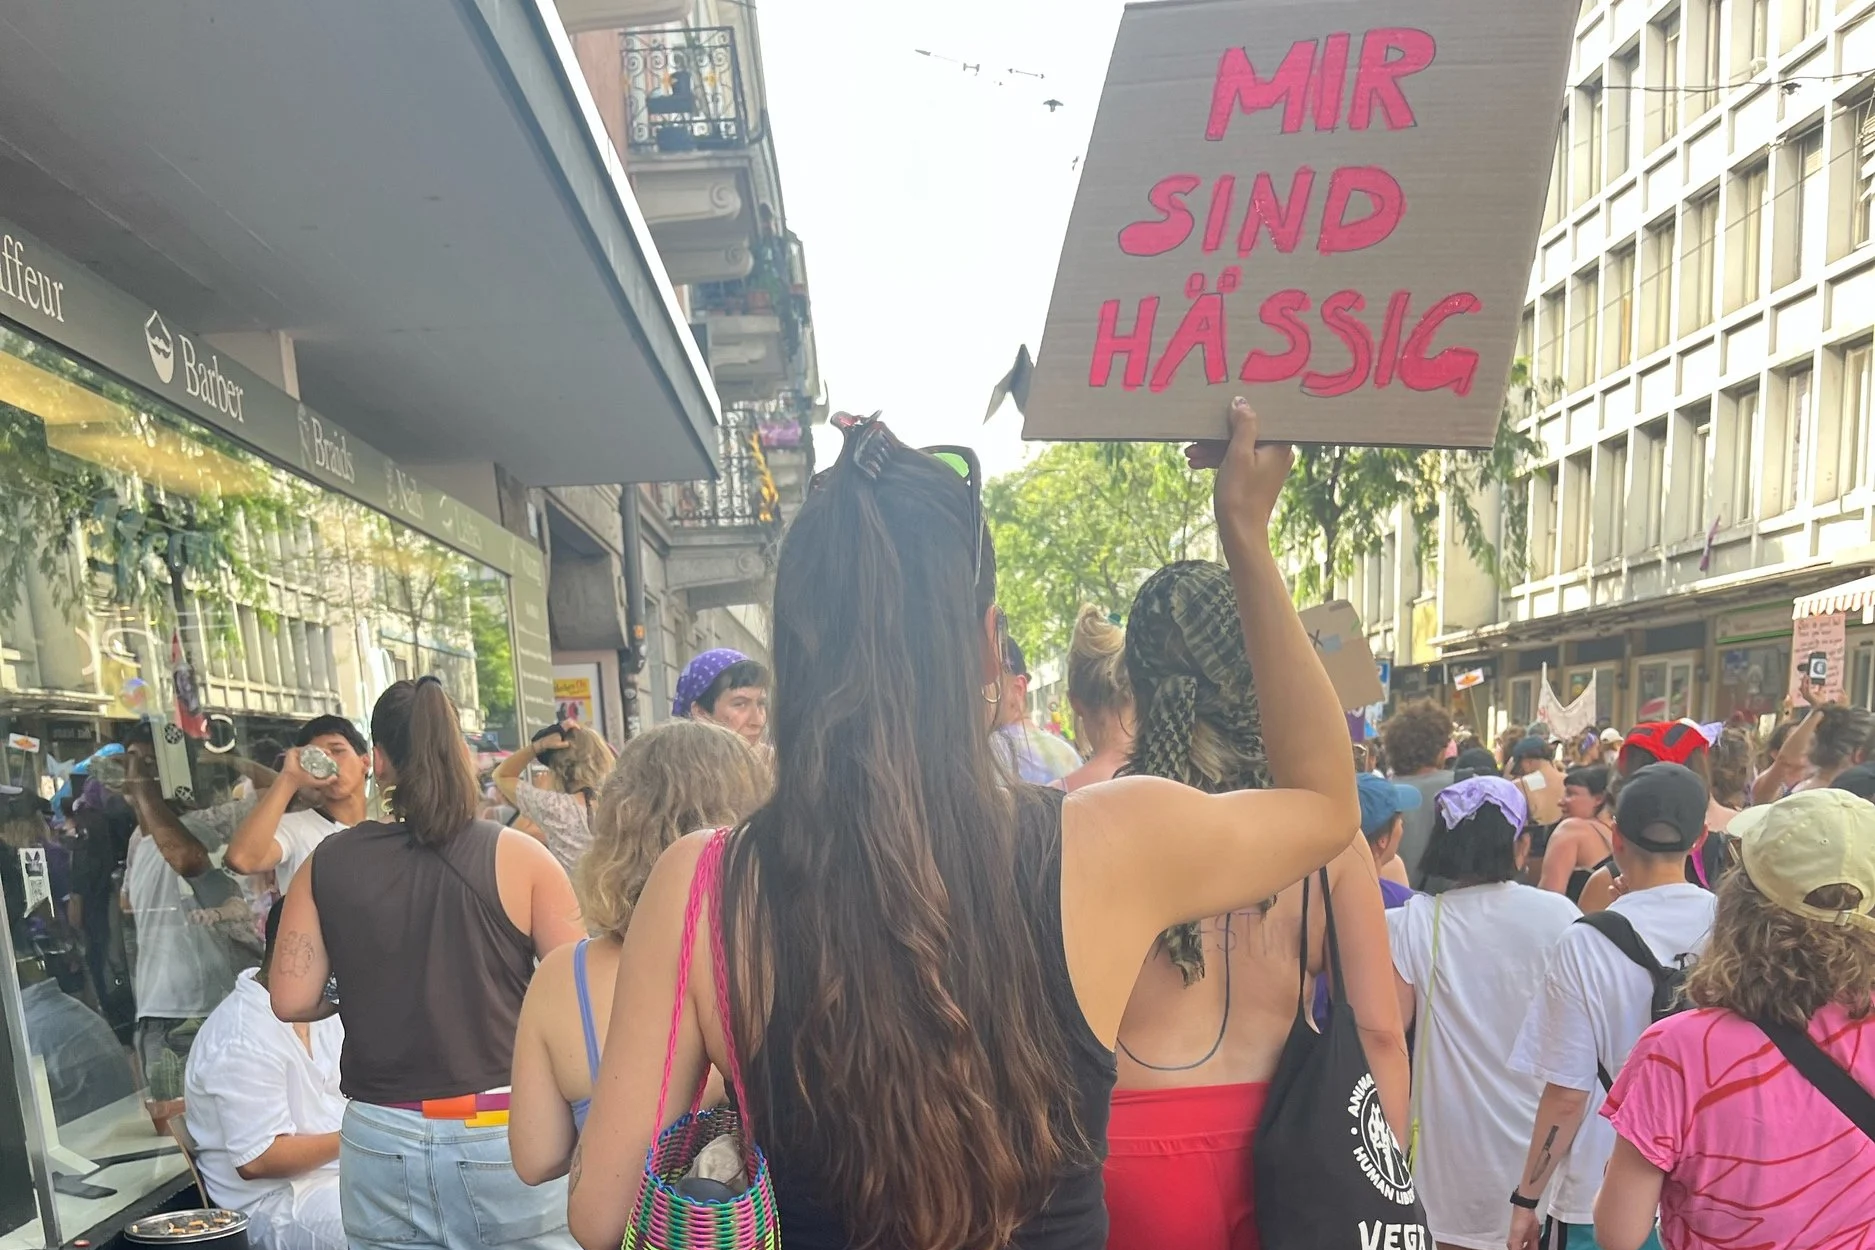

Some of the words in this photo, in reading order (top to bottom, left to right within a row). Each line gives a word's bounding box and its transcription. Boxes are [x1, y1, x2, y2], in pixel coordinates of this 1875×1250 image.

[1205, 27, 1436, 141] MIR
[1118, 165, 1407, 257] SIND
[1089, 265, 1483, 397] HÄSSIG
[179, 334, 245, 424] Barber
[311, 416, 355, 484] Braids
[1353, 1146, 1395, 1201] HUMAN
